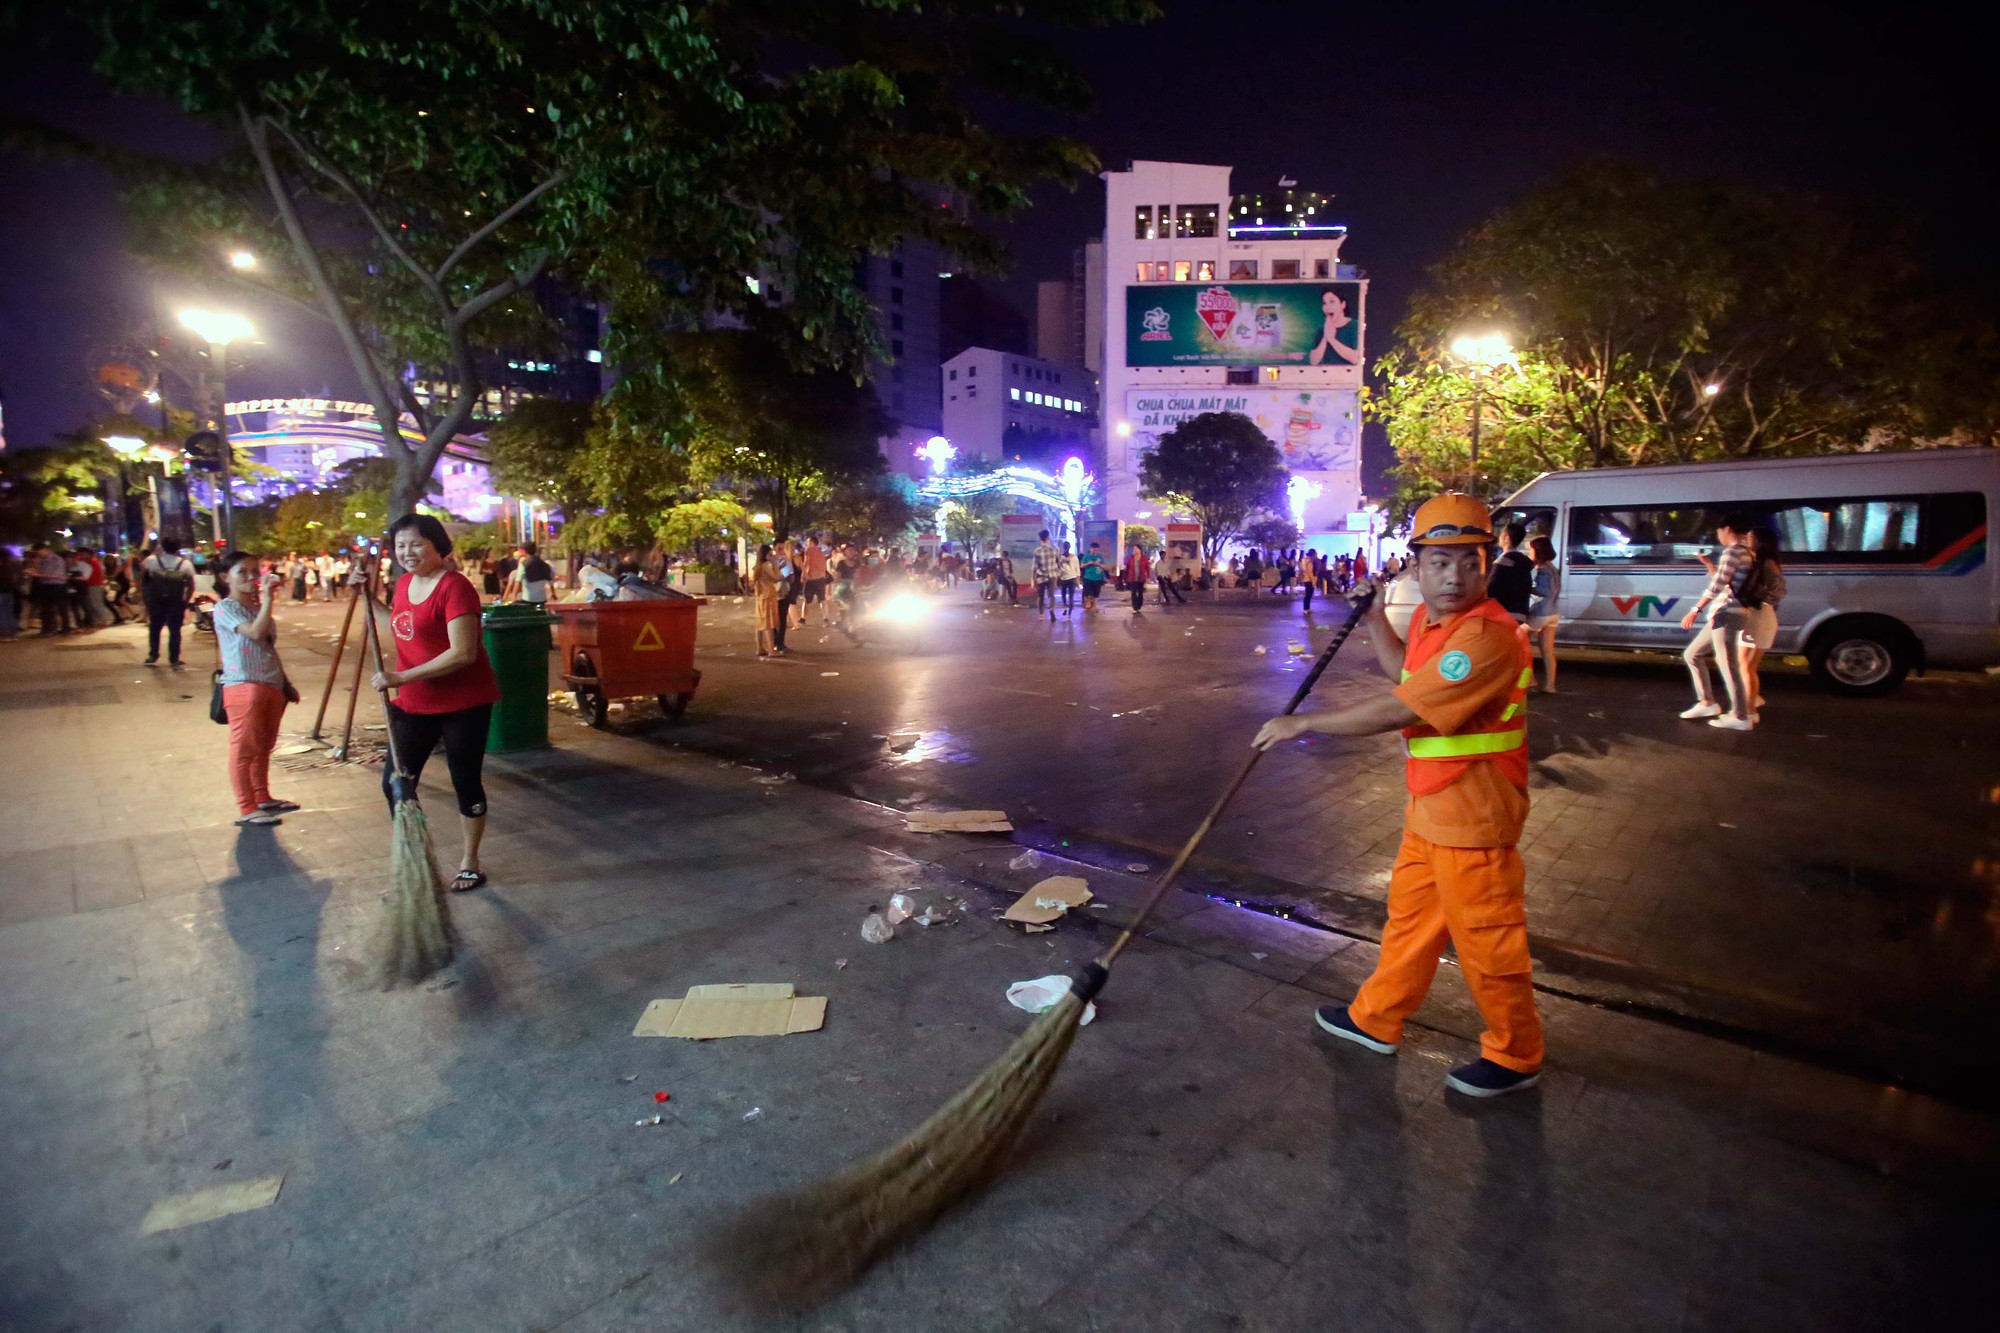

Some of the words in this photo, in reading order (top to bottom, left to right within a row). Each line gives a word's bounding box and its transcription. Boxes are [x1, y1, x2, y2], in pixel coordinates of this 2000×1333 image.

[1141, 331, 1173, 341] ARIEL
[224, 399, 284, 415] HAPPY
[335, 401, 376, 415] YEAR
[1137, 399, 1164, 411] CHUA
[1167, 399, 1195, 411] CHUA
[1199, 396, 1222, 410] MÁT
[1224, 396, 1248, 410] MÁT
[1143, 412, 1159, 426] ĐÃ
[1610, 595, 1680, 618] VTV
